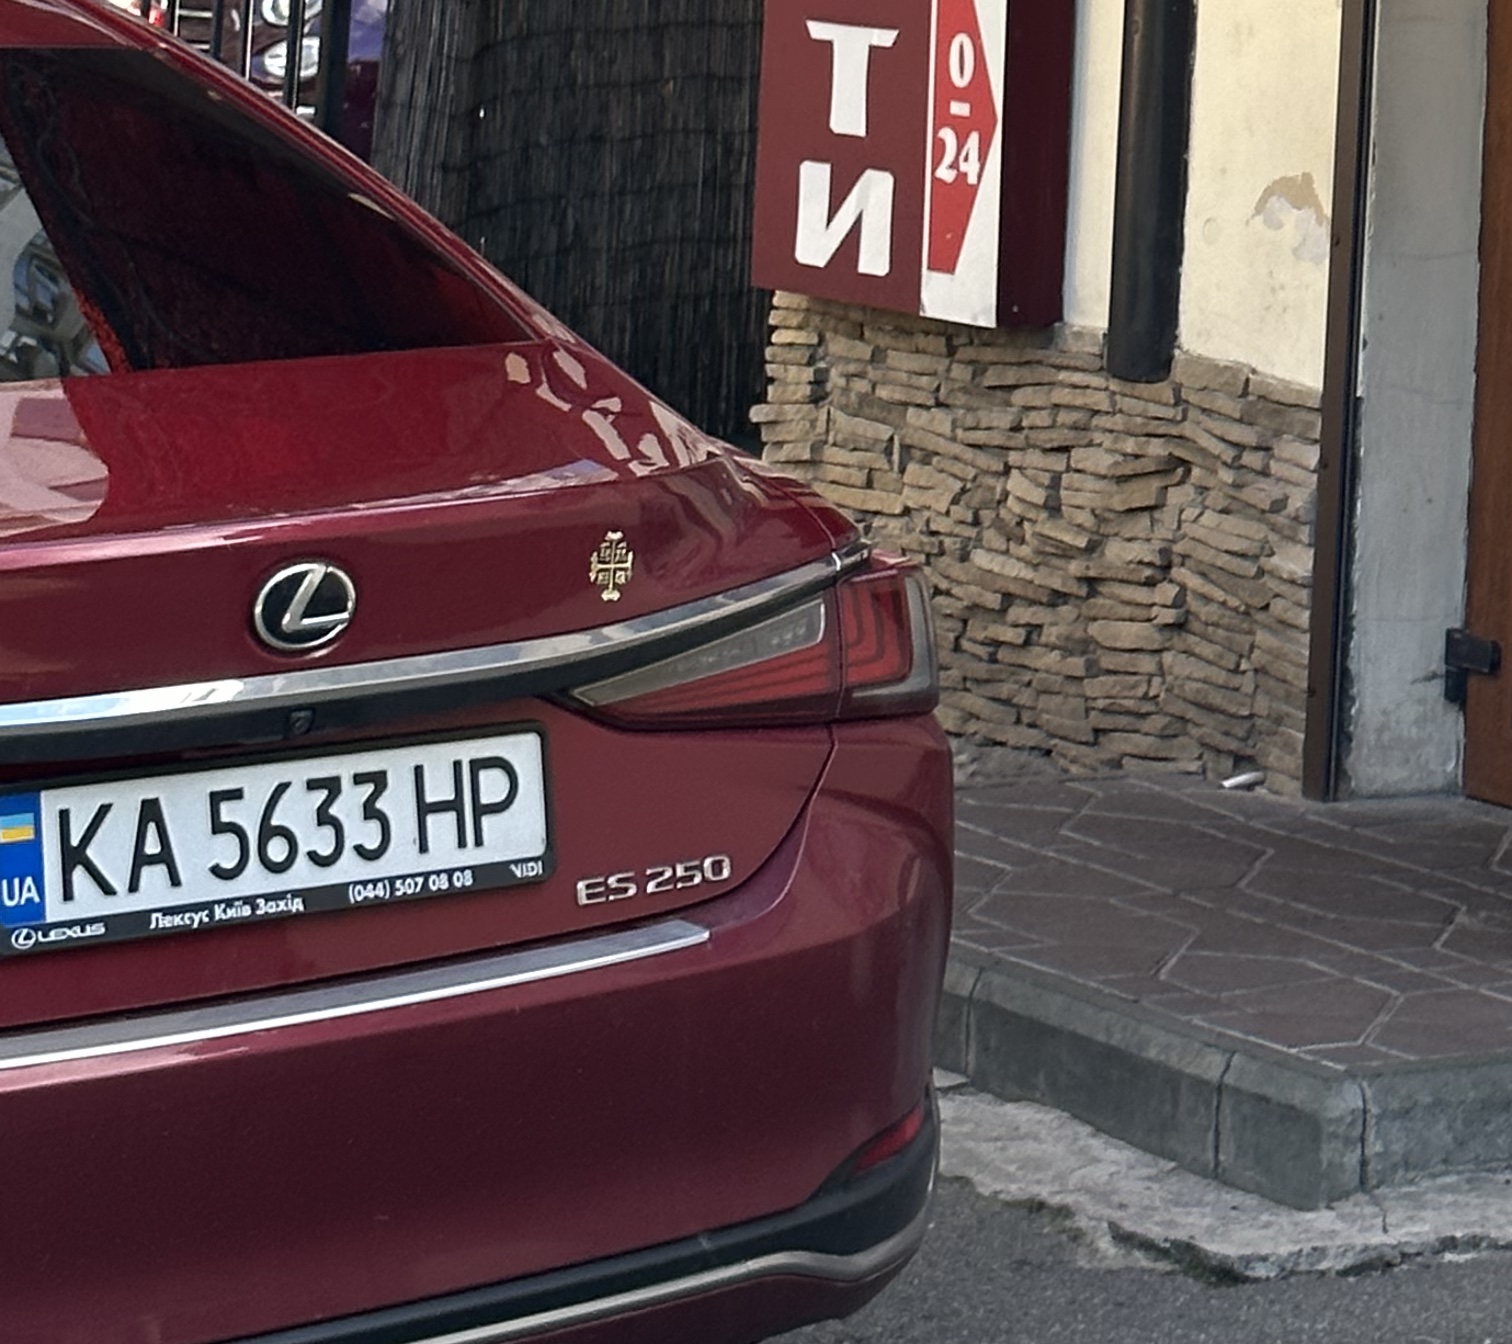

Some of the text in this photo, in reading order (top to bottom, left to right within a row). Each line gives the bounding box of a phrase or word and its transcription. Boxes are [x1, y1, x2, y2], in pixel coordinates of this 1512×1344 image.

[58, 755, 519, 903] KA 5633 HP
[509, 860, 544, 879] VIDI
[576, 854, 731, 906] ES 250
[2, 878, 40, 907] UA
[348, 880, 390, 904] (044)
[395, 876, 425, 897] 507
[149, 912, 209, 930] Лексус
[214, 902, 251, 921] Київ
[37, 922, 106, 943] LEXUS
